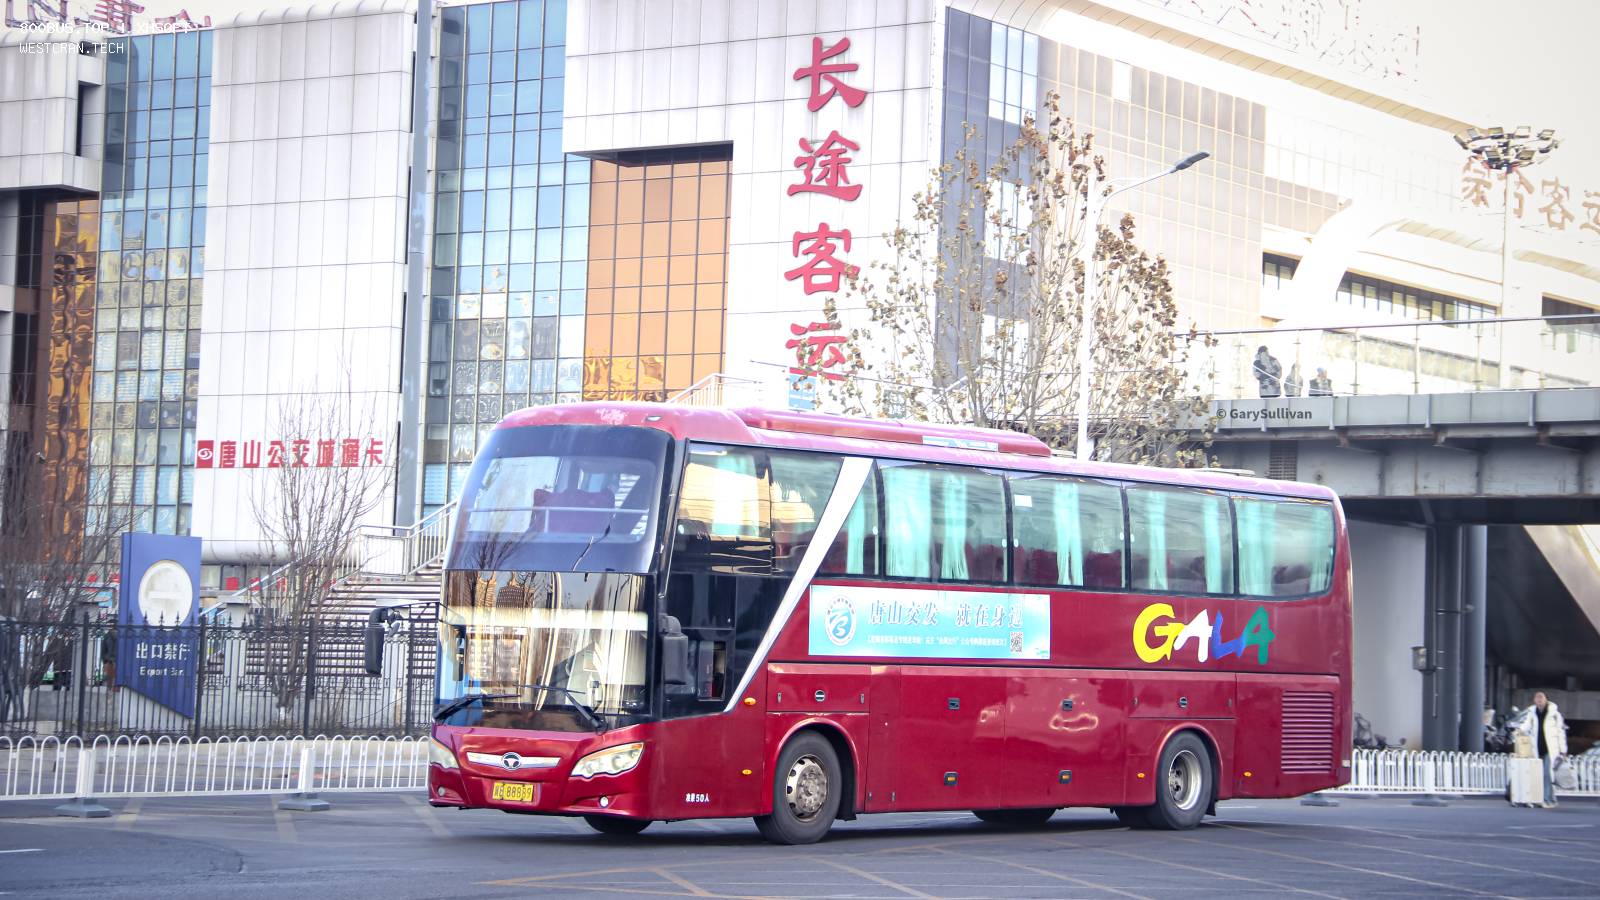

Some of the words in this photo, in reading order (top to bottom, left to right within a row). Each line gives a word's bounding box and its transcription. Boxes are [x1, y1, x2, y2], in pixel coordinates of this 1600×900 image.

[784, 36, 868, 382] 长途客运
[219, 438, 384, 468] 唐山公交城通卡
[868, 600, 938, 625] 唐山交发
[956, 604, 1024, 628] 就在身边
[1132, 602, 1276, 665] GALA
